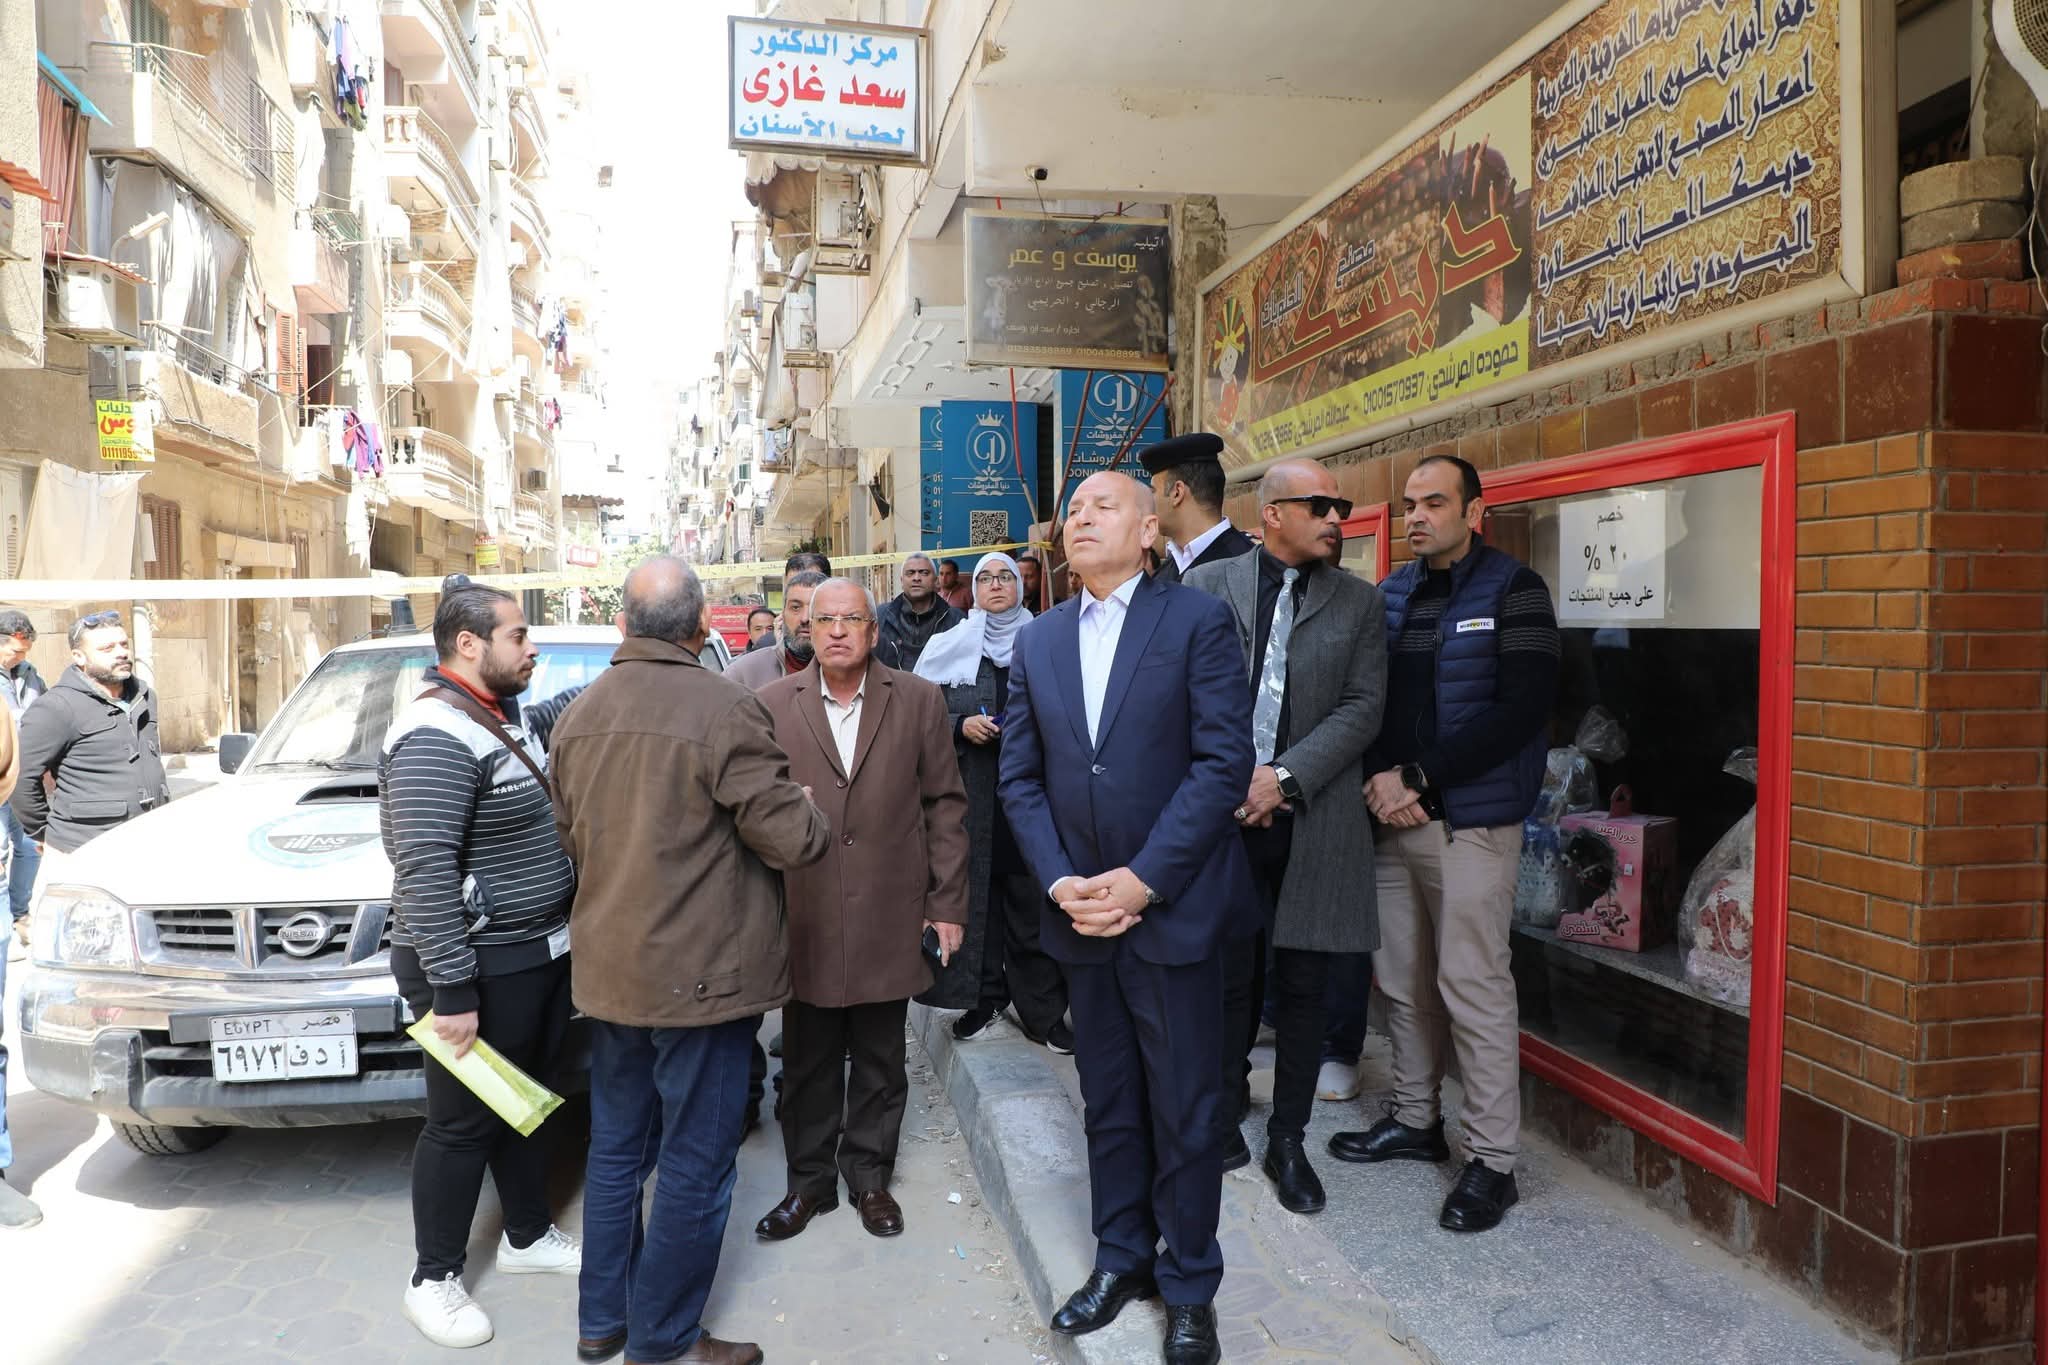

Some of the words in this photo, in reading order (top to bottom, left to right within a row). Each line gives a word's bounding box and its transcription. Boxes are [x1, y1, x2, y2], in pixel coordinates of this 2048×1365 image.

[750, 27, 837, 56] الدكتور
[843, 35, 898, 67] مركز
[840, 75, 906, 109] سعد
[1604, 65, 1657, 136] المولد
[1745, 46, 1816, 138] اسعار
[846, 124, 905, 147] لطب
[1667, 82, 1744, 179] المصنع
[1052, 250, 1065, 270] و
[1073, 247, 1138, 273] يوسف
[1477, 339, 1519, 377] حموده
[1073, 451, 1132, 465] الفروشات
[1597, 505, 1623, 531] خصم
[1584, 544, 1601, 571] %
[1568, 587, 1605, 606] المنتجات
[1608, 590, 1631, 608] جميع
[224, 1019, 272, 1036] EGYPT
[302, 1015, 340, 1030] مصر
[217, 1044, 282, 1074] ٦٩٧٣
